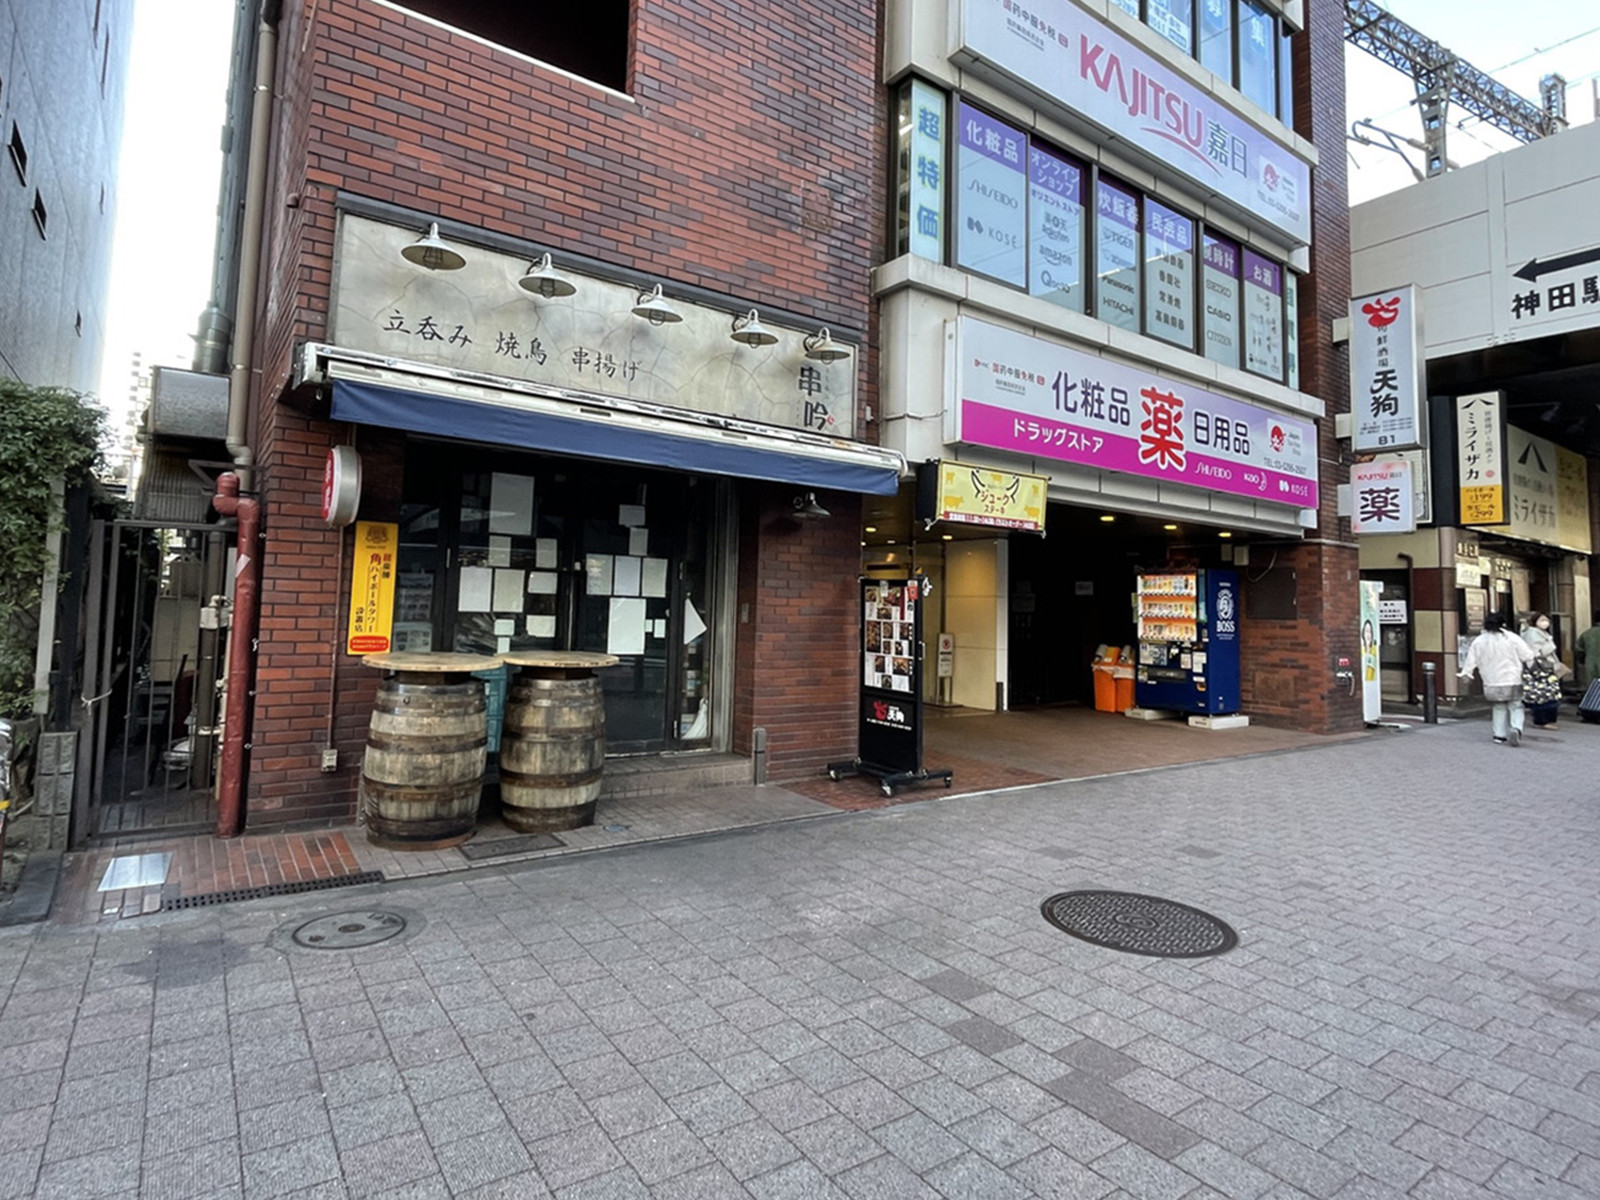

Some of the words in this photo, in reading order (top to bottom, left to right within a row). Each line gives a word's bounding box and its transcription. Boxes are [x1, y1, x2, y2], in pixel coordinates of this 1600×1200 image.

[1080, 33, 1202, 147] KAJITSU
[1207, 120, 1248, 179] 嘉日
[966, 118, 1019, 164] 化粧品
[917, 108, 940, 240] 超特価
[1031, 151, 1080, 183] オンライン
[1037, 170, 1074, 196] ショップ
[967, 179, 1018, 209] SHISEIDO
[1039, 244, 1073, 266] amazon
[1102, 297, 1135, 316] HITACHI
[1206, 305, 1232, 322] CASIO
[383, 309, 473, 348] 立呑み
[495, 331, 548, 366] 焼鳥
[571, 346, 643, 382] 串揚げ
[798, 366, 829, 431] 串吟
[1052, 370, 1131, 427] 化粧品
[1371, 368, 1399, 418] 天狗
[1014, 418, 1104, 453] ドラッグストア
[1139, 386, 1185, 468] 薬
[1193, 410, 1250, 456] 日用品
[1378, 434, 1396, 446] B1
[1464, 411, 1481, 480] ミライザカ
[1194, 462, 1232, 481] SHISEIDO
[1359, 486, 1400, 523] 薬
[367, 552, 382, 633] 角ハイボールタワー
[1216, 620, 1235, 632] BOSS
